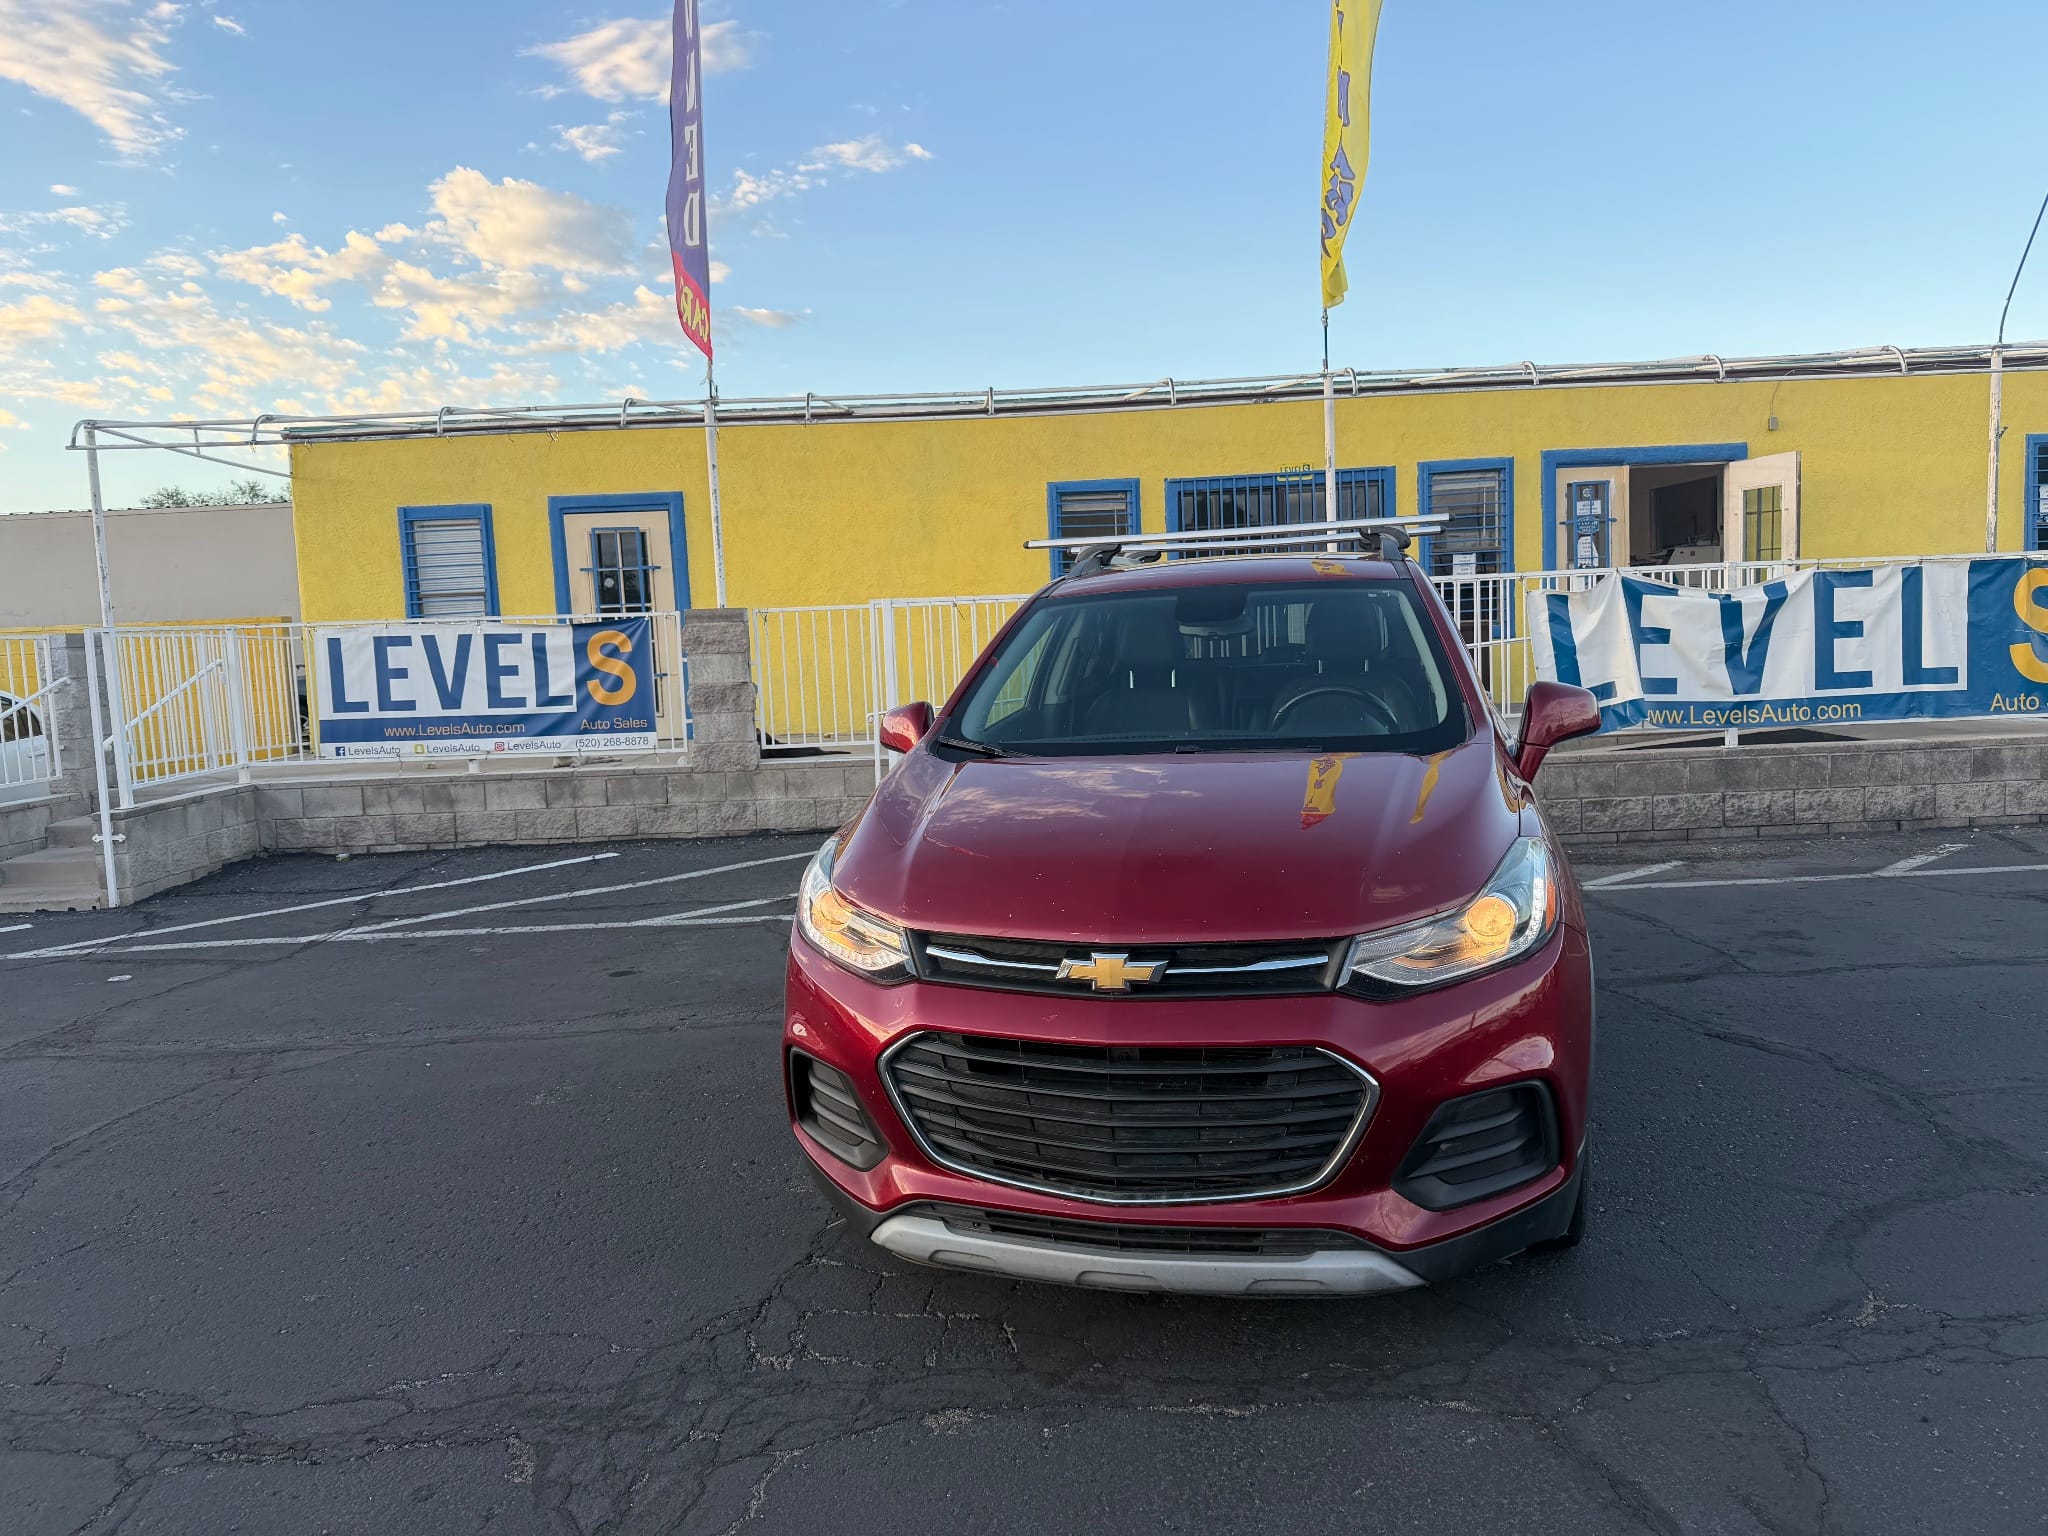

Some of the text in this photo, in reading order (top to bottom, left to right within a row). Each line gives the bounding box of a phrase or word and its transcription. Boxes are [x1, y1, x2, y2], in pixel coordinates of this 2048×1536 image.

[326, 630, 637, 713] LEVELS
[1990, 693, 2040, 712] Auto
[1648, 703, 1862, 725] ww.LevelsAuto.com
[384, 721, 525, 737] www.LevelsAuto.com
[580, 717, 648, 730] Auto Sales
[427, 743, 481, 754] LevelsAuto
[507, 740, 562, 751] LevelsAuto
[575, 736, 649, 748] (520) 268-8878
[348, 745, 400, 756] LevelsAuto
